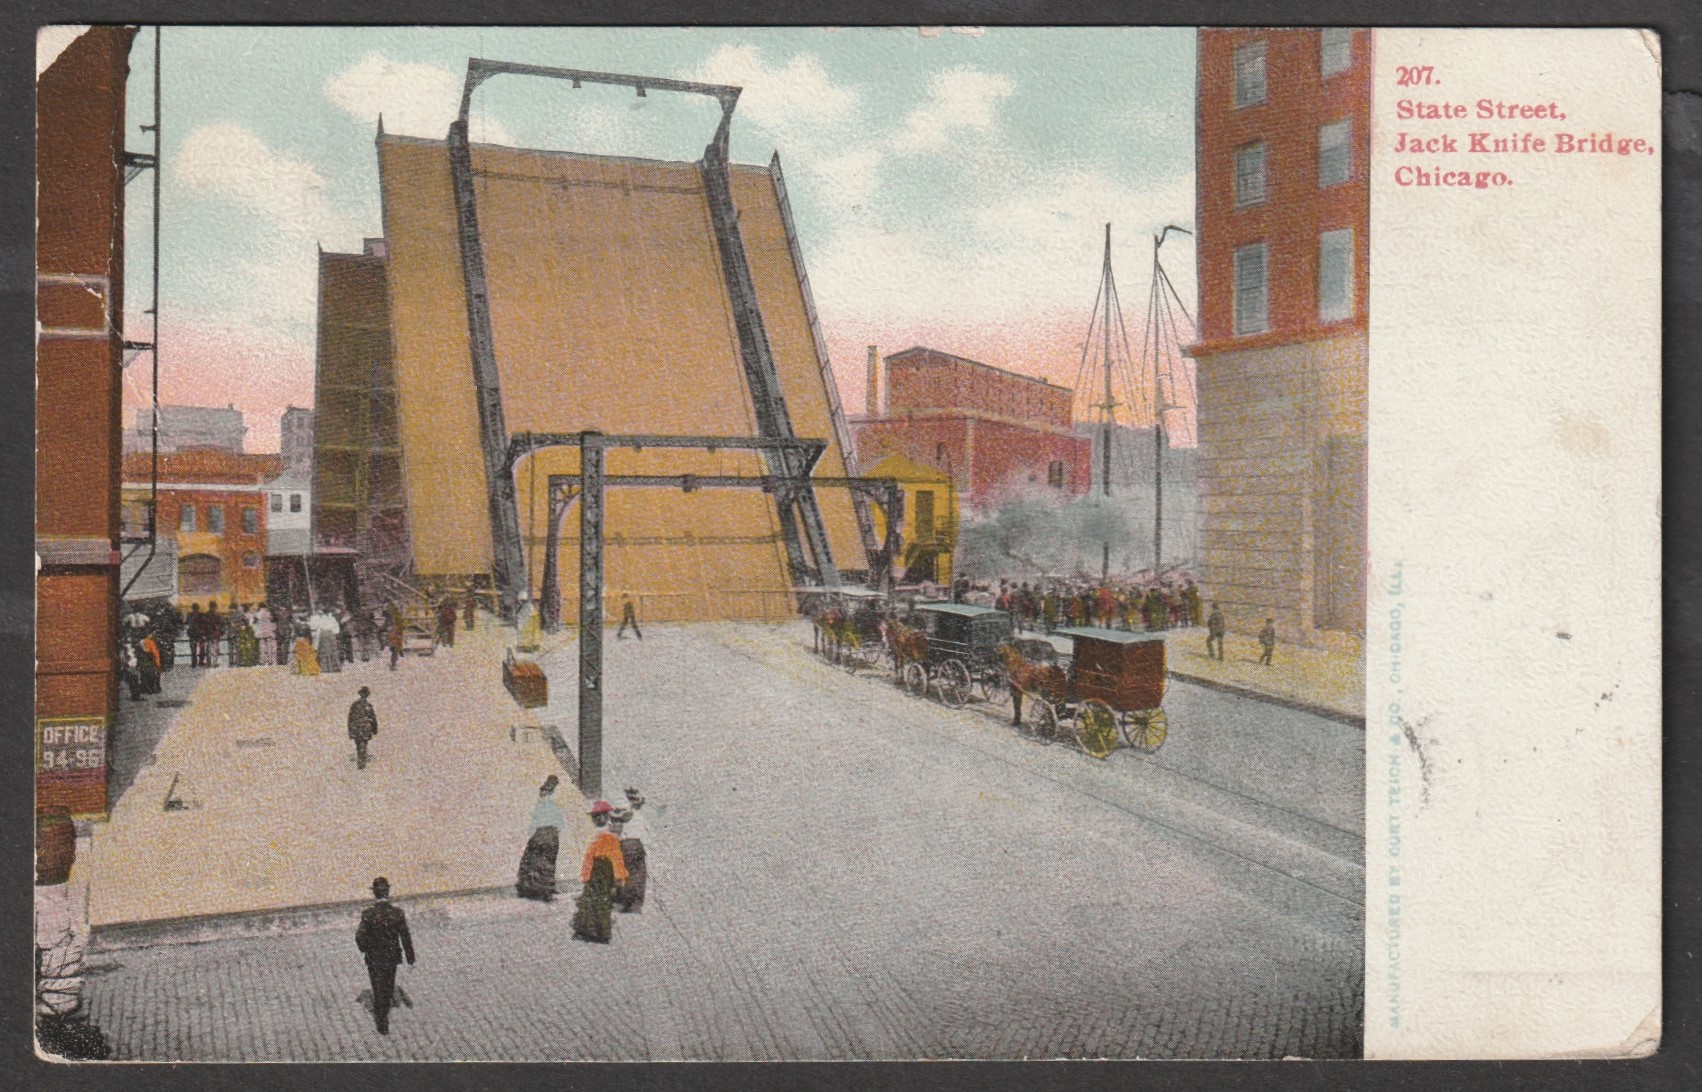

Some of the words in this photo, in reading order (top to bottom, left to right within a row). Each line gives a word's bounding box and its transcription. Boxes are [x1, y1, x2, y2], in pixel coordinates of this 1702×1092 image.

[1395, 65, 1441, 87] 207.
[1396, 99, 1467, 120] State
[1476, 99, 1567, 121] Street,
[1394, 132, 1458, 154] Jack
[1468, 132, 1546, 154] Knife
[1555, 132, 1655, 156] Bridge,
[1394, 165, 1513, 189] Chicago.
[43, 725, 99, 744] OFFICE
[1388, 755, 1400, 806] TEICH
[1388, 815, 1400, 858] CURT
[1388, 866, 1400, 886] BY
[1388, 894, 1400, 1028] MANUFACTURED
